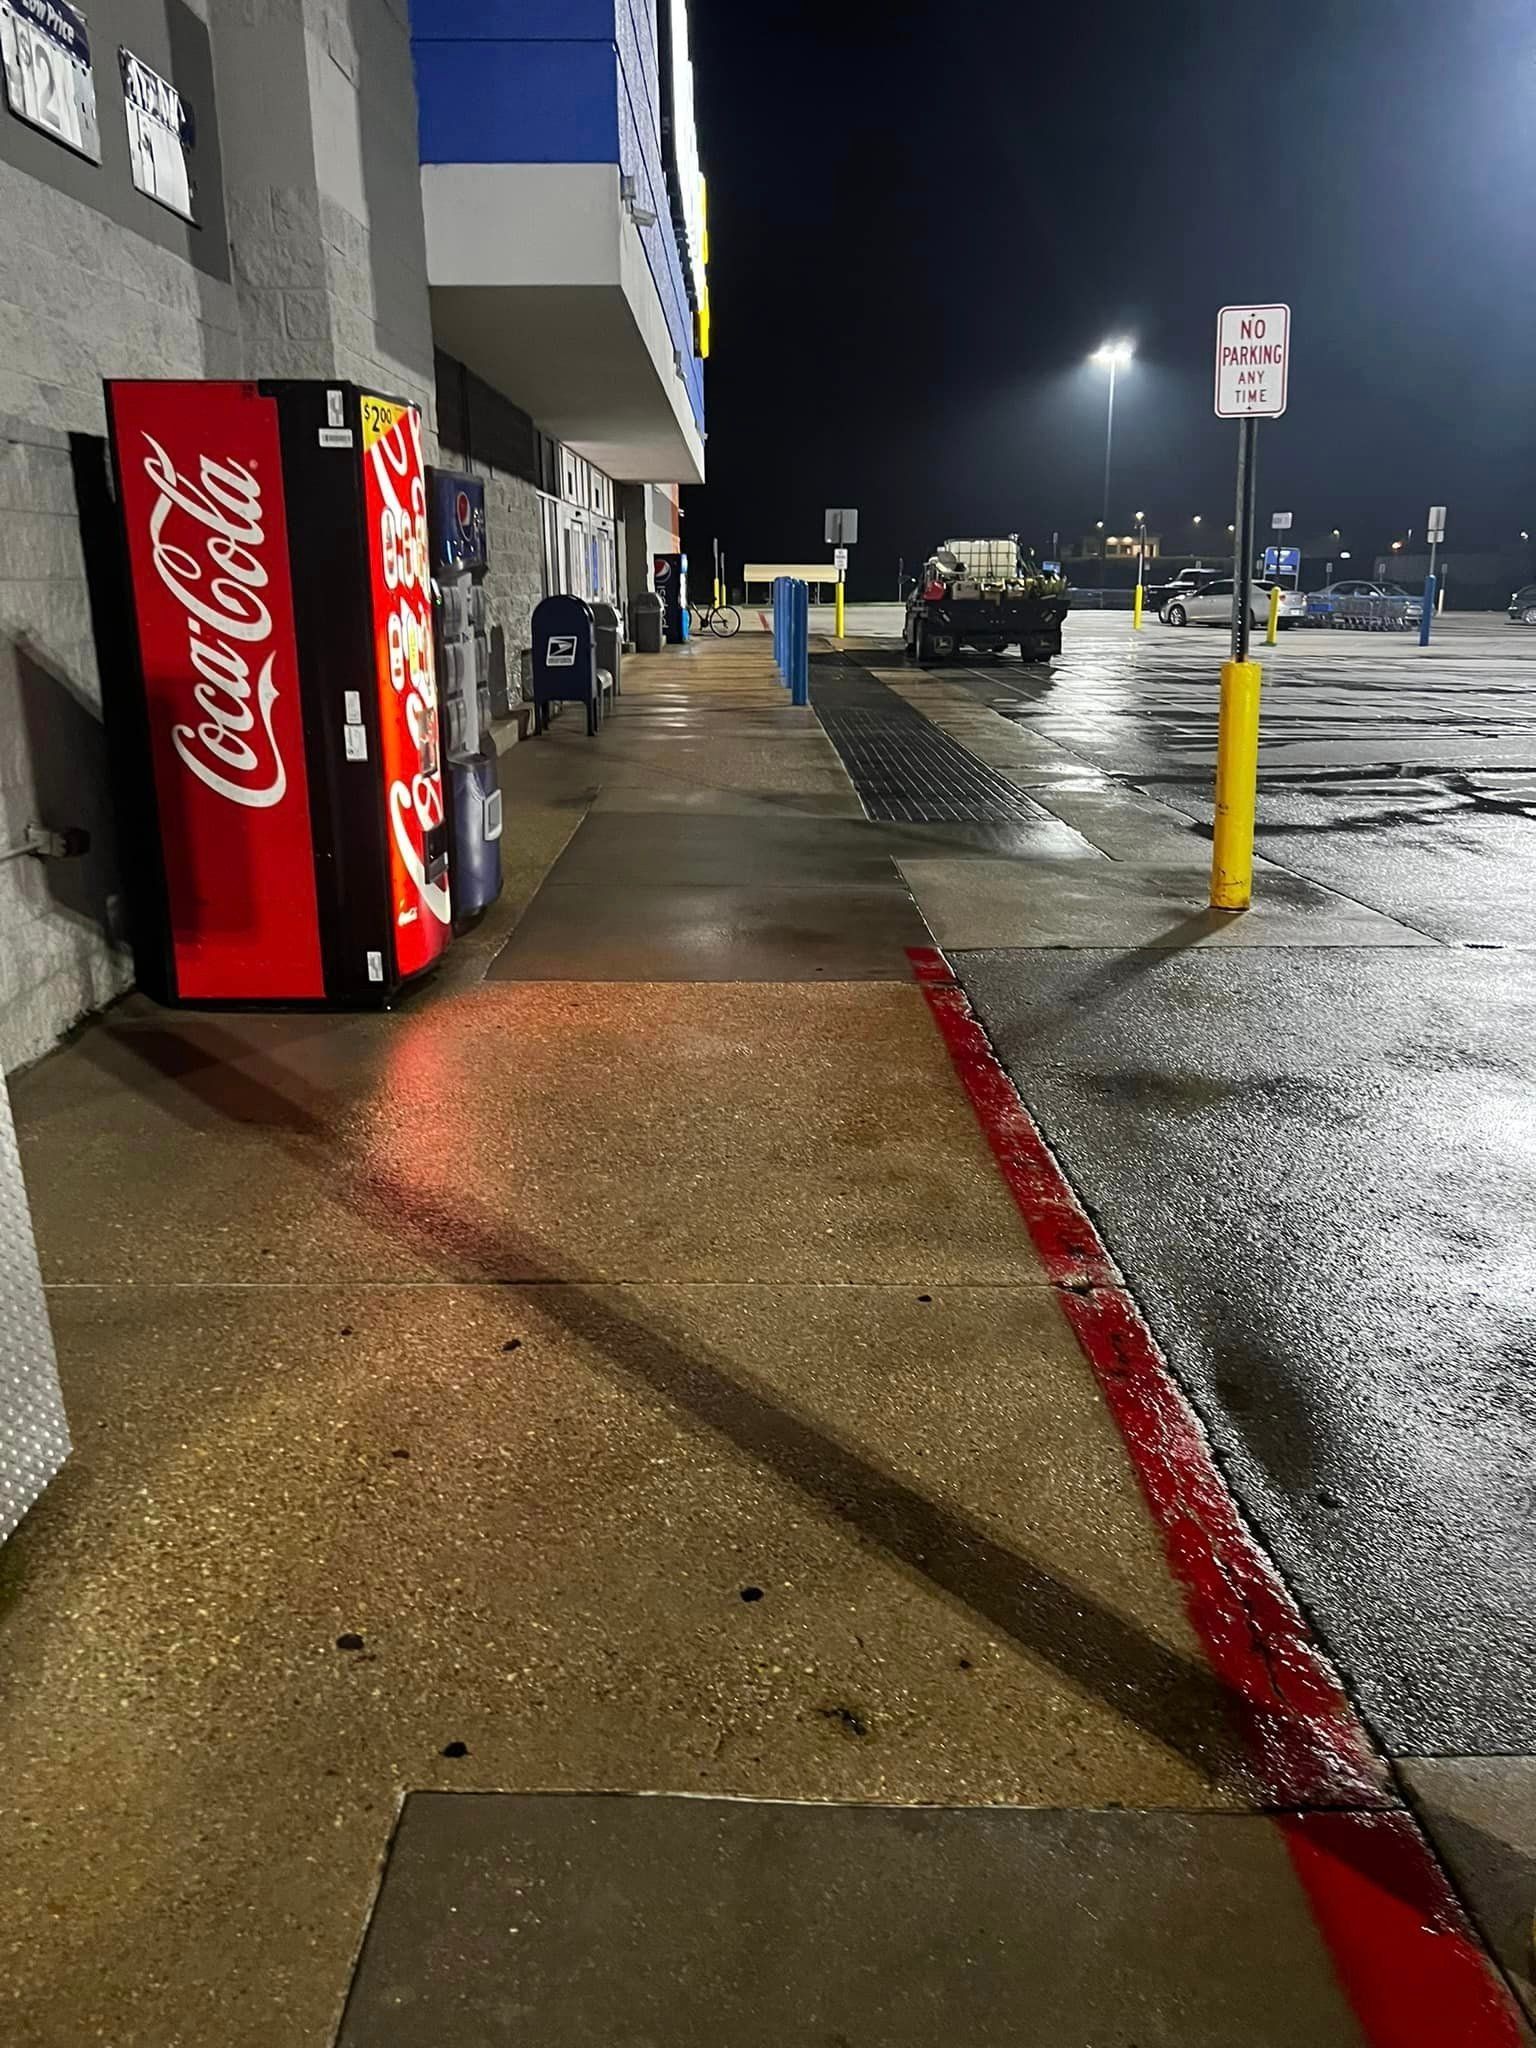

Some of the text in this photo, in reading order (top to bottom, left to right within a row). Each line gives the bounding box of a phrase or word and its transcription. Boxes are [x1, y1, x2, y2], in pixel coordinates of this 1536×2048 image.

[46, 2, 75, 45] Price
[1240, 319, 1266, 340] NO
[1222, 344, 1282, 366] PARKING
[1238, 370, 1265, 385] ANY
[1235, 388, 1267, 403] TIME
[141, 431, 288, 809] Coca-Cola
